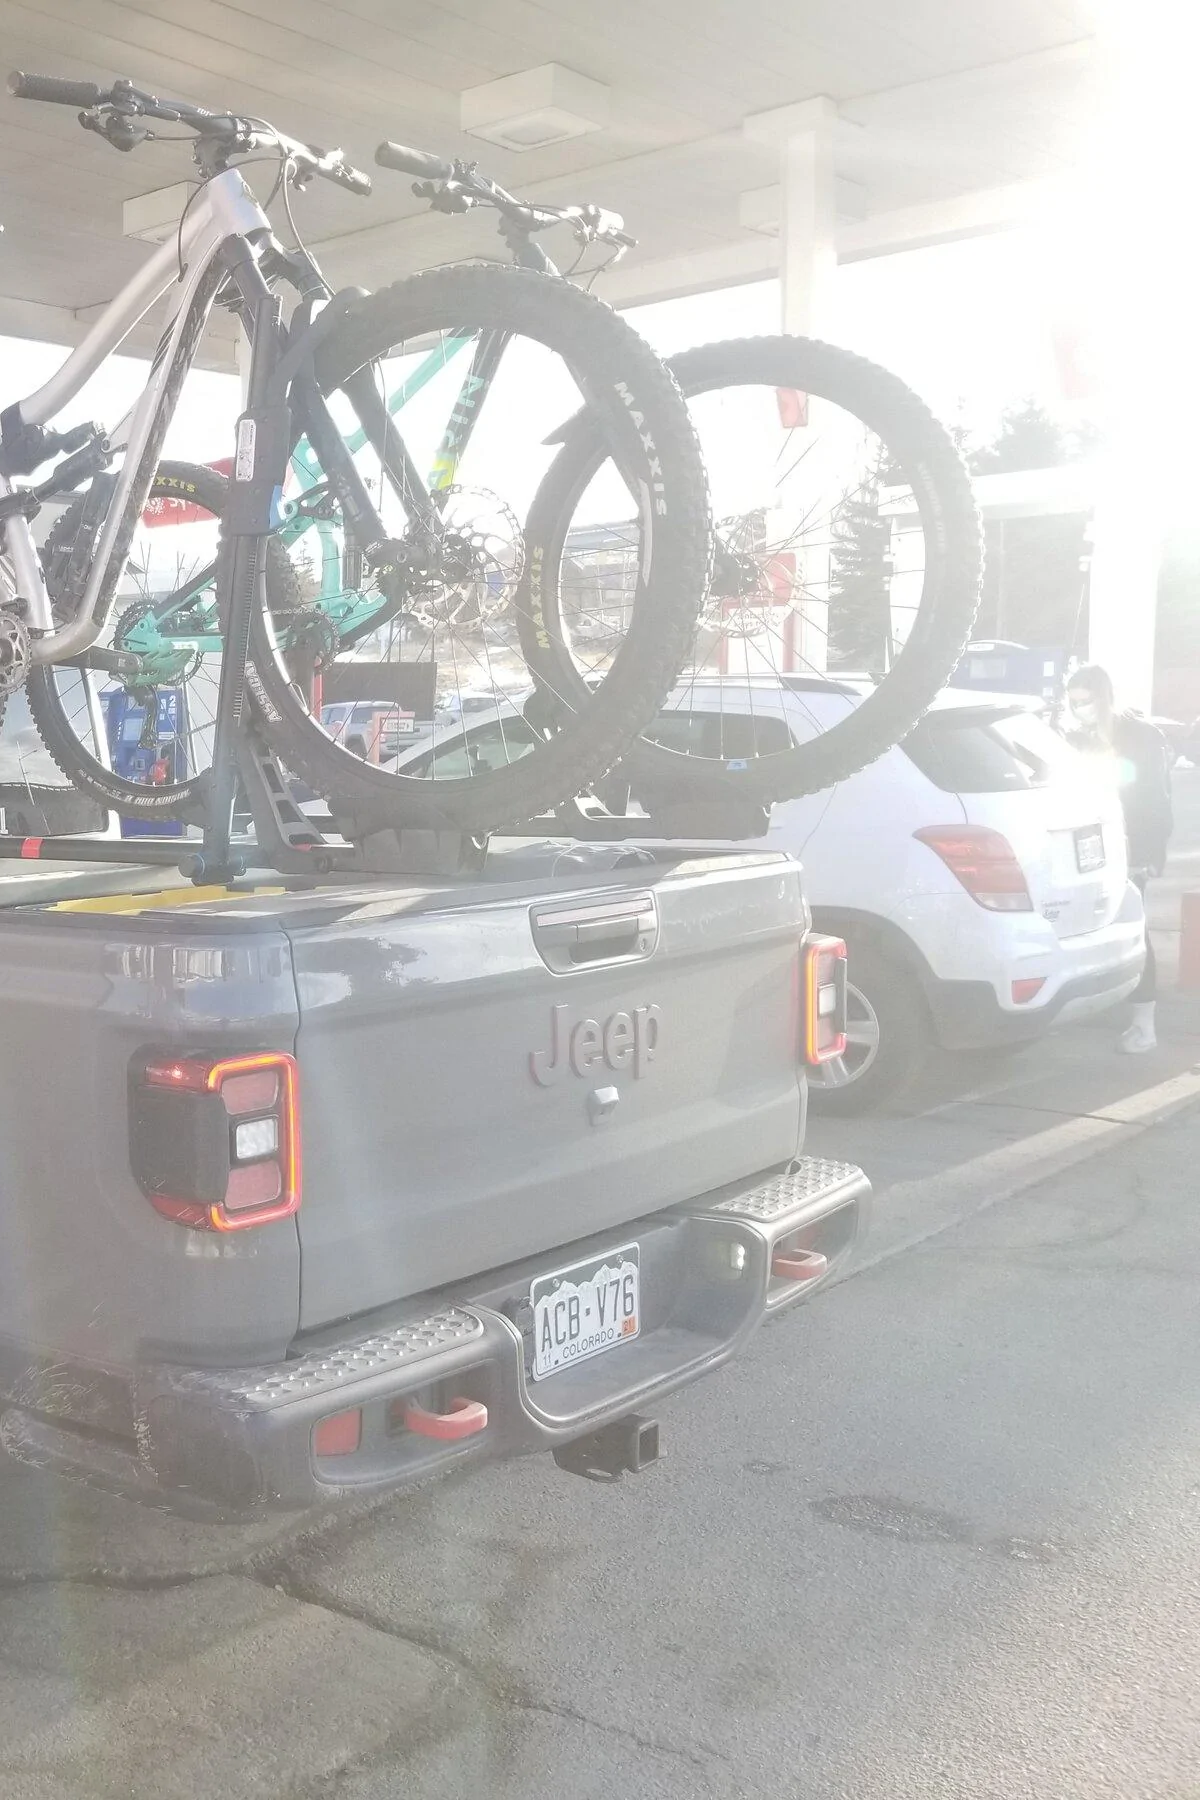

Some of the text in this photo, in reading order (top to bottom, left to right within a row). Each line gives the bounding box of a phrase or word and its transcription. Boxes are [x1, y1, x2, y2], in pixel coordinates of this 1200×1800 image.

[153, 476, 196, 493] XXIS
[614, 381, 668, 516] MAXXIS
[530, 545, 551, 649] MAXXIS
[529, 1003, 663, 1088] Jeep
[562, 1327, 615, 1359] COLORADO
